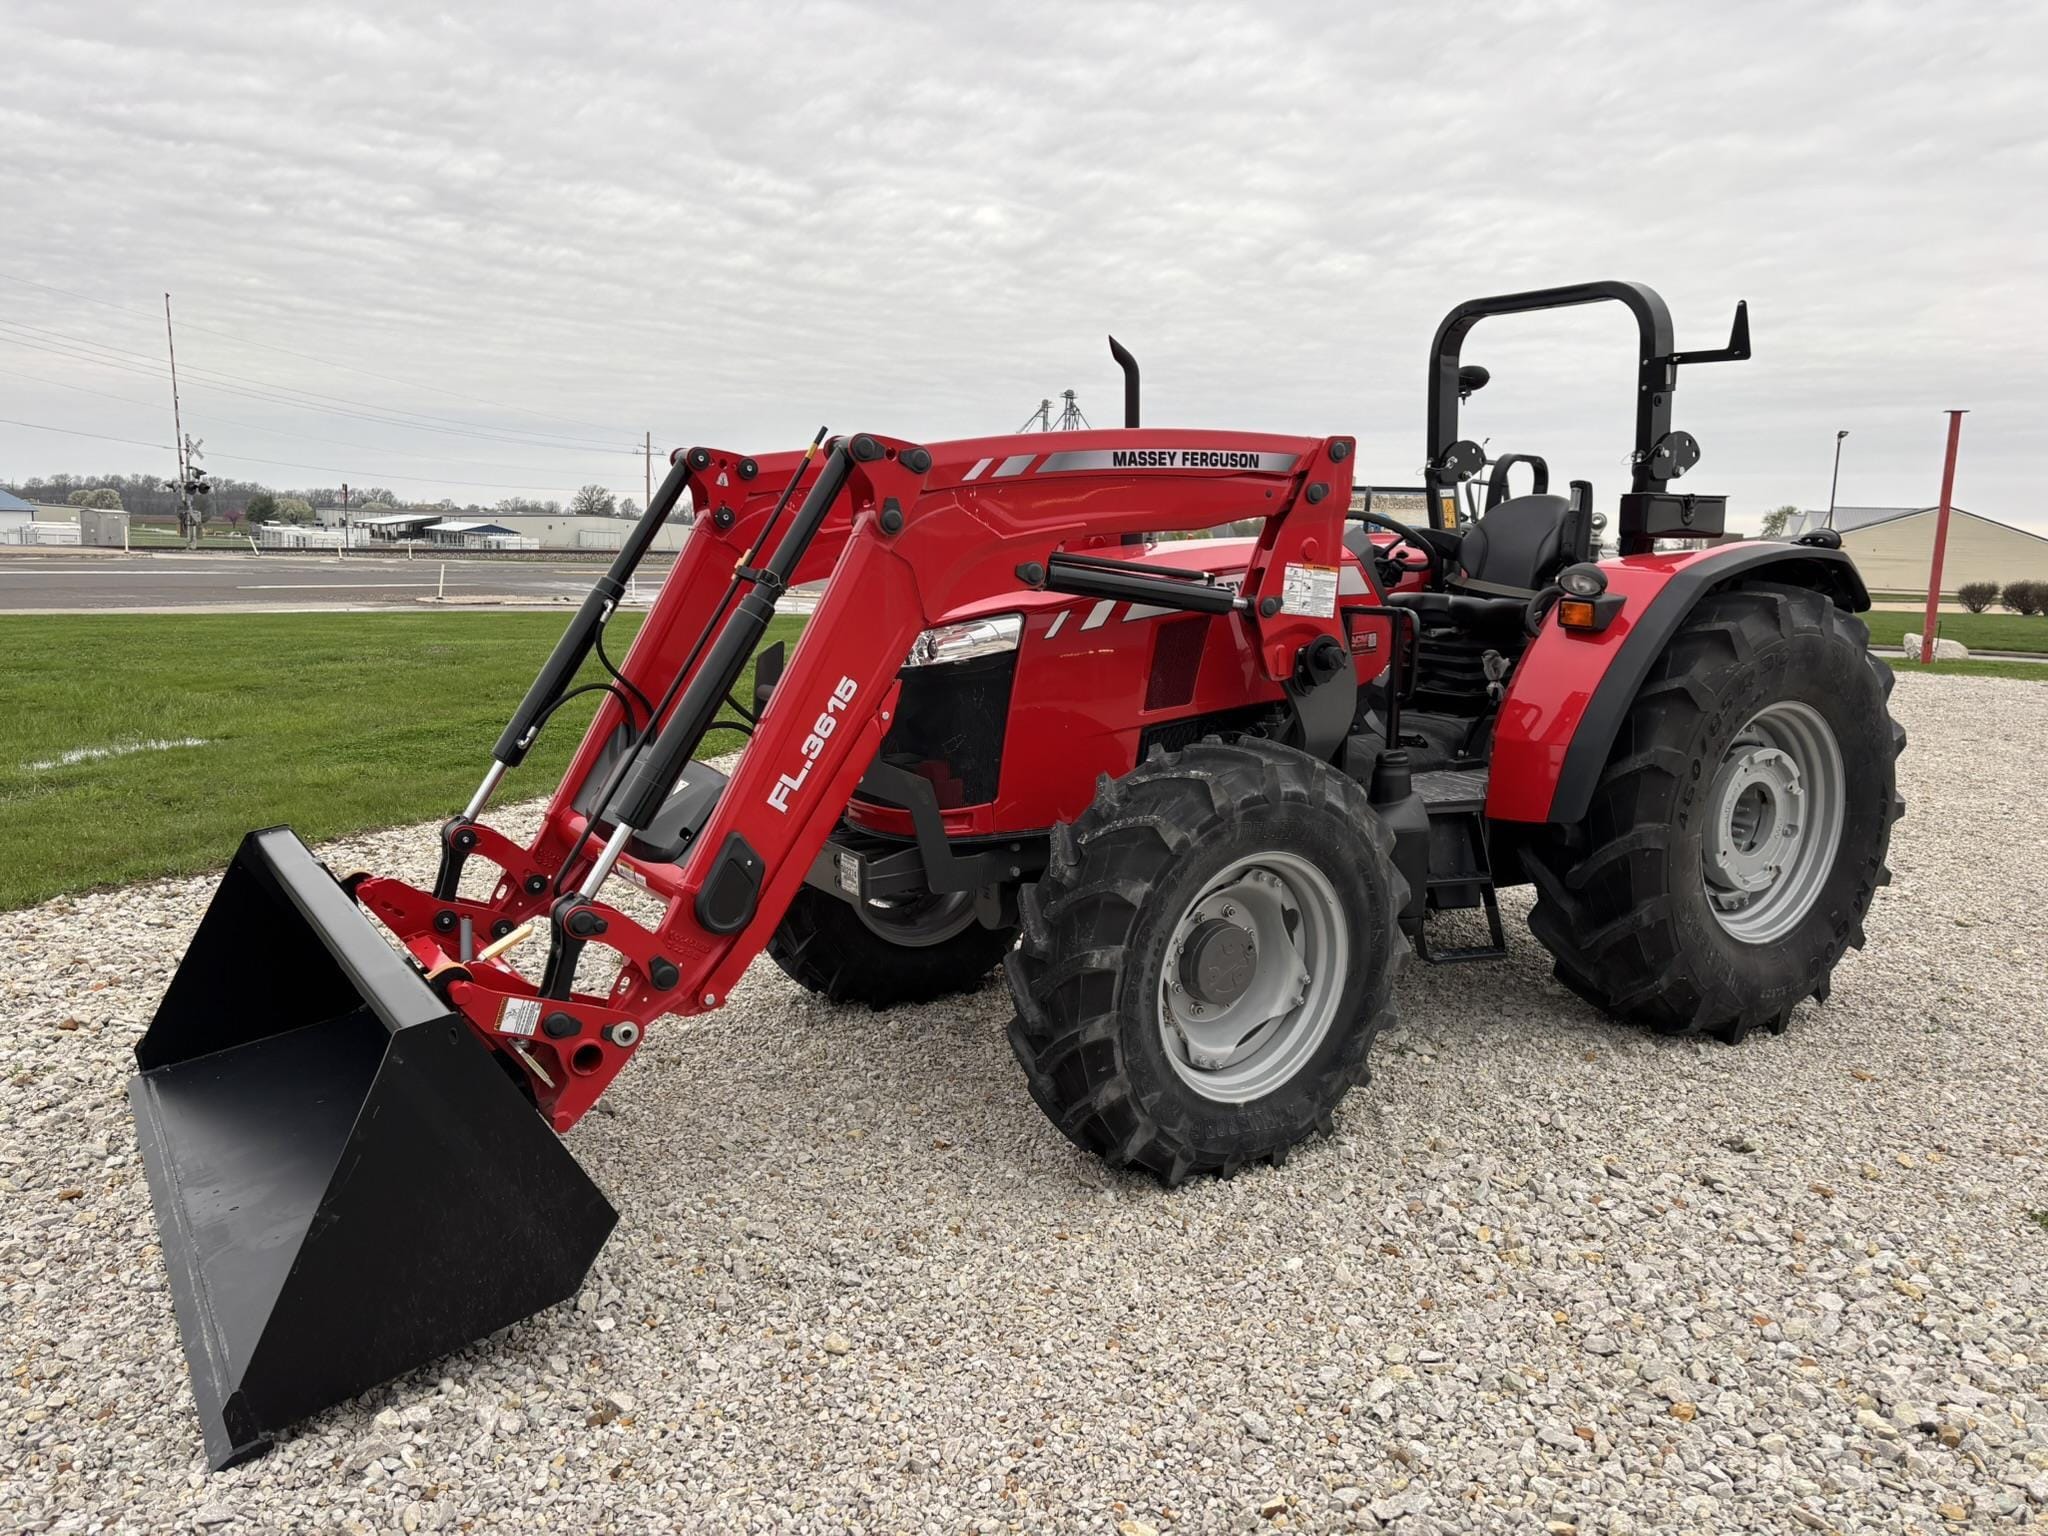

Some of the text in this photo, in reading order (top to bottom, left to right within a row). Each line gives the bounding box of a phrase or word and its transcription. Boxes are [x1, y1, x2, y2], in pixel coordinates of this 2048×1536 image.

[1112, 451, 1260, 468] MASSEY FERGUSON
[766, 675, 859, 814] FL.3615
